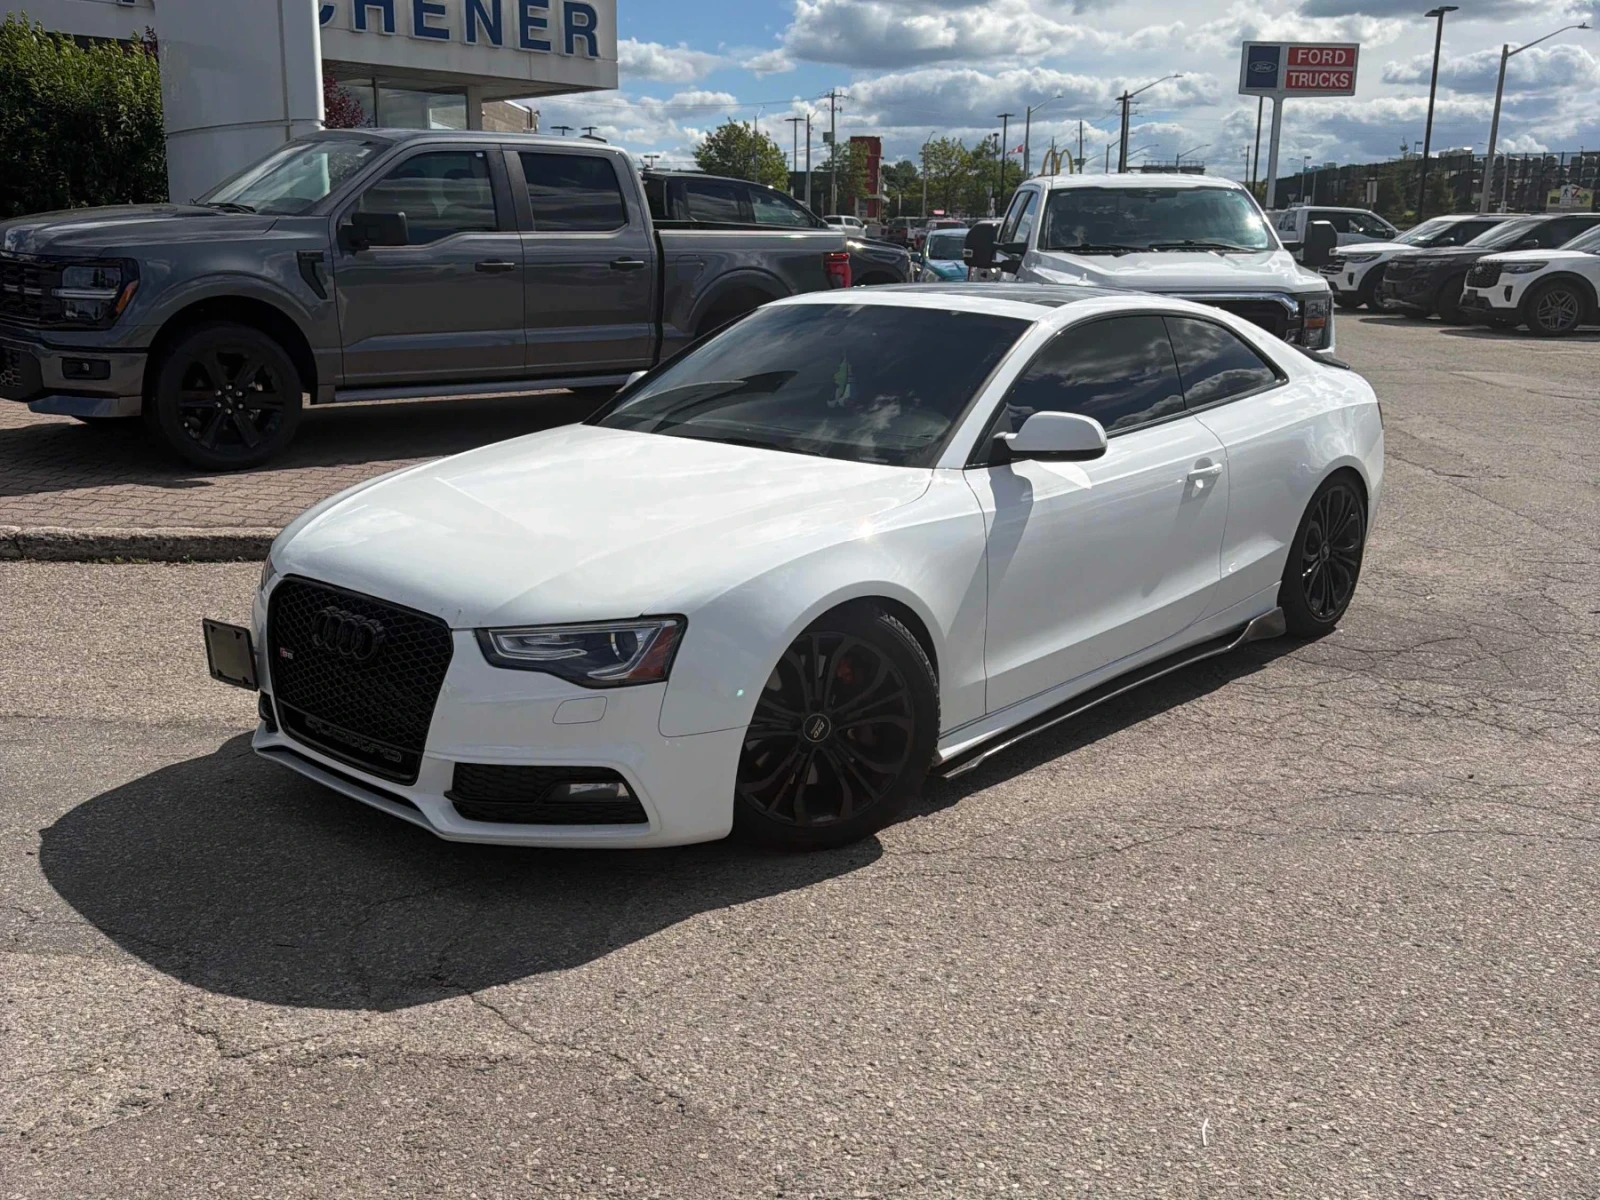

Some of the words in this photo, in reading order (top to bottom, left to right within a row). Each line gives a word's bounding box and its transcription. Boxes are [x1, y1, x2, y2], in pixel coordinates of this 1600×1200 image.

[320, 0, 600, 58] HENER
[1297, 49, 1346, 65] FORD
[1289, 72, 1349, 87] TRUCKS
